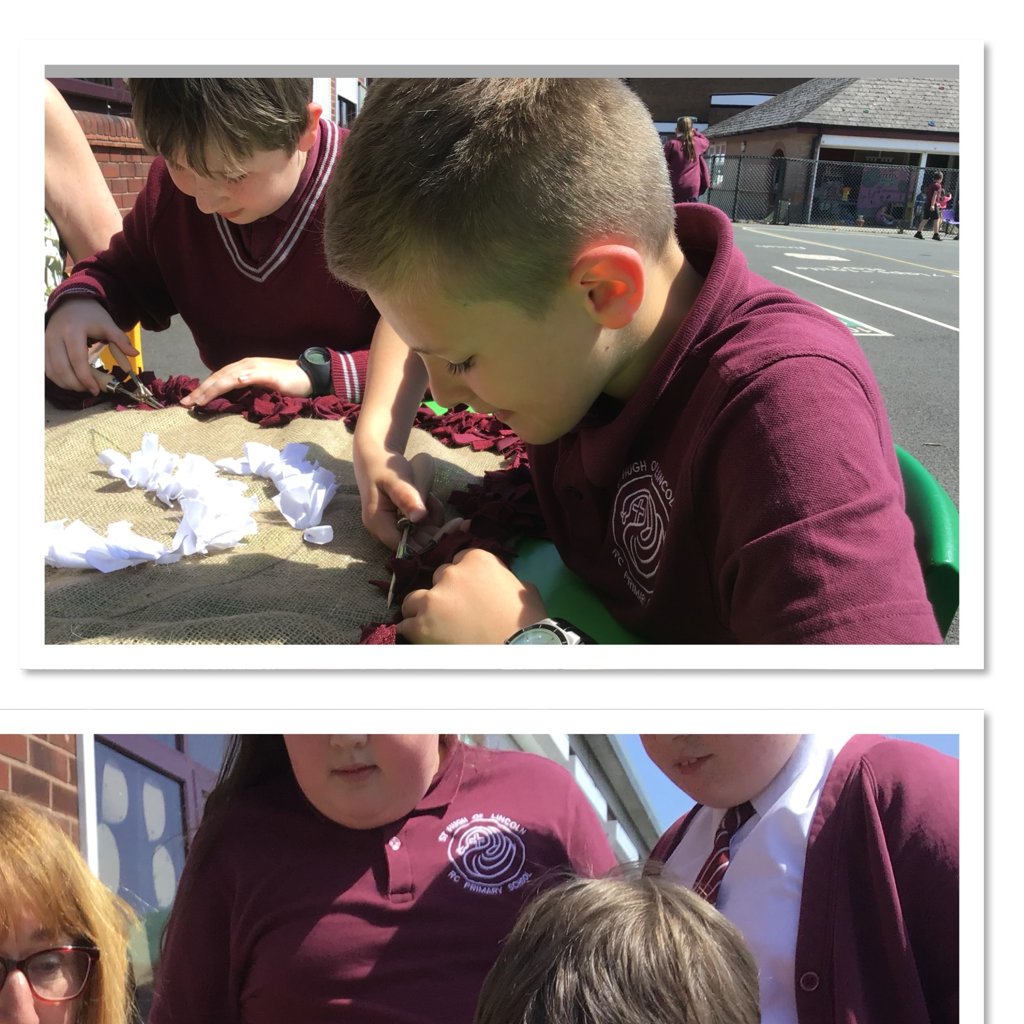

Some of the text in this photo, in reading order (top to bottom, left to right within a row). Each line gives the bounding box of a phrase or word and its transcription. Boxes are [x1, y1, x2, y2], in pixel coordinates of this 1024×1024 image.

[438, 830, 449, 842] ST
[446, 816, 469, 833] HUGH
[491, 813, 527, 835] LINCOLN
[447, 870, 461, 882] RC
[463, 881, 503, 895] PRIMARY
